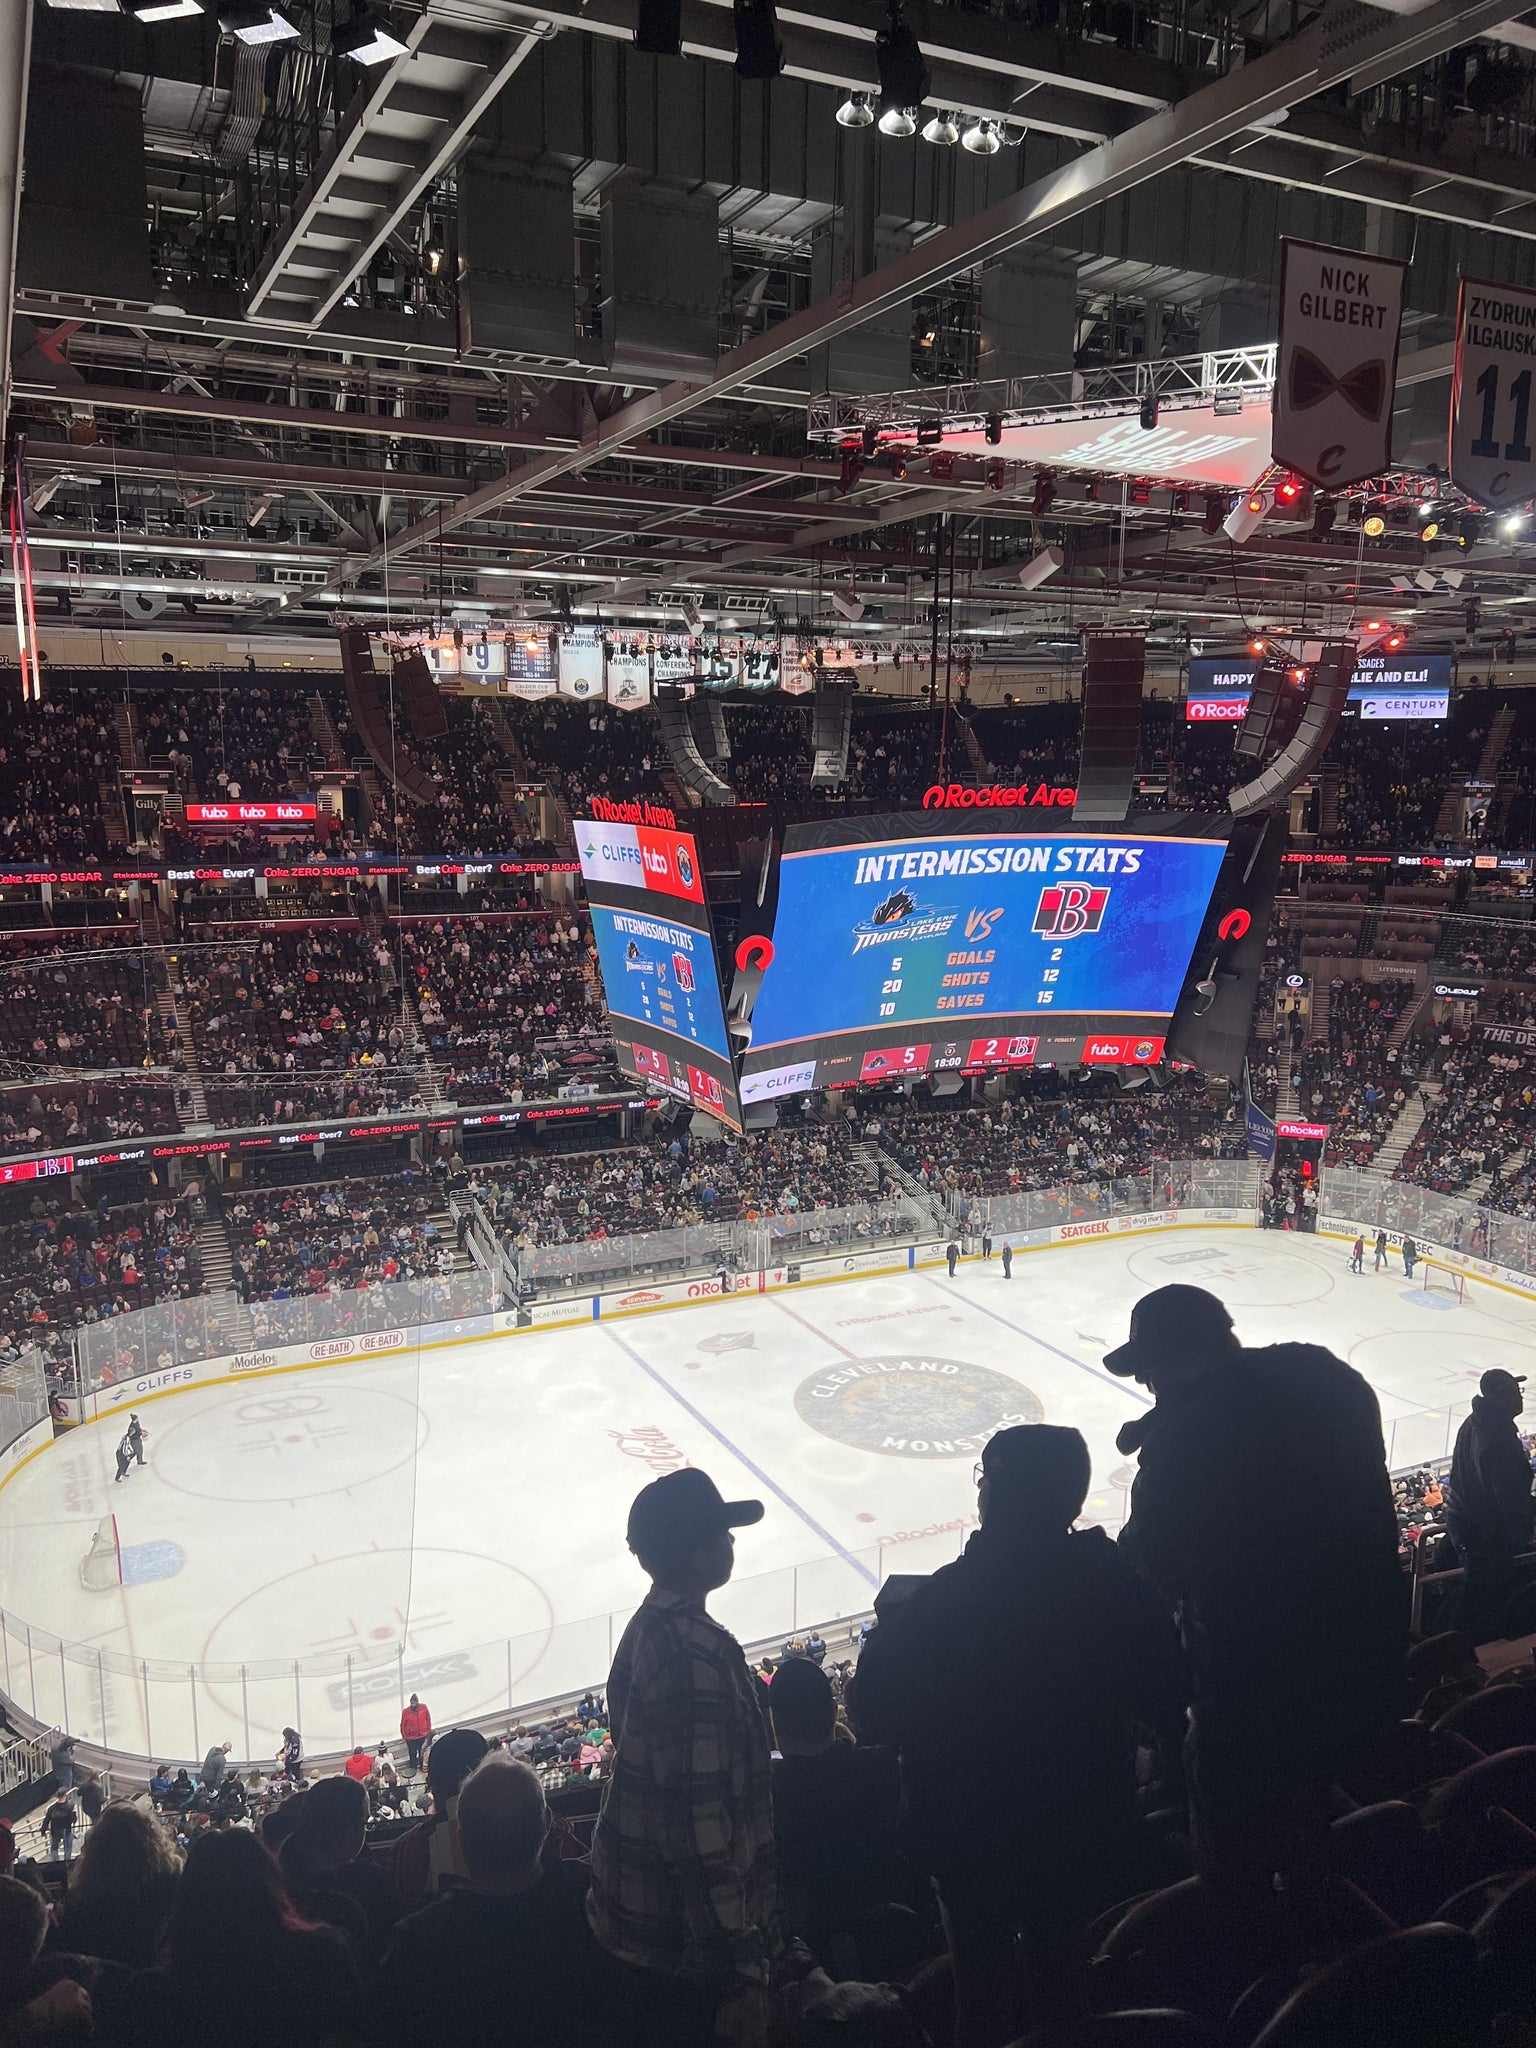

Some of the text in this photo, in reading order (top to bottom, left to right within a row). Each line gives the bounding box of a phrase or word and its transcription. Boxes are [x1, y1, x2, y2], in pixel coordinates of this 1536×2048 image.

[1320, 265, 1370, 297] NICK
[1299, 292, 1387, 329] GILBERT
[1467, 324, 1536, 355] ILGAUSK
[1470, 364, 1532, 462] 11
[1049, 449, 1188, 471] FEAR THE
[1316, 444, 1346, 477] C
[1489, 472, 1511, 497] C
[475, 643, 489, 670] 9
[609, 658, 647, 667] CHAMPIONS
[1357, 658, 1385, 669] SSAGES
[1213, 673, 1255, 685] HAPPY
[1375, 671, 1401, 683] AND
[1404, 668, 1428, 682] ELI!
[1385, 700, 1446, 709] CENTURY
[944, 783, 1029, 808] Rocket
[201, 806, 303, 818] fubo fubo fubo
[603, 798, 677, 829] Rocket Arena
[602, 844, 641, 865] CLIFFS
[643, 846, 668, 874] fubo
[1287, 854, 1347, 863] ZERO SUGAR
[1398, 856, 1421, 866] Best
[1421, 857, 1444, 866] Coke
[1444, 857, 1472, 867] Ever?
[264, 867, 359, 877] Coke ZERO SUGAR
[416, 864, 492, 874] Best Coke Ever?
[501, 863, 522, 872] Coke
[523, 863, 550, 871] ZERO
[854, 847, 1144, 885] INTERMISSION STATS
[25, 873, 58, 883] ZERO
[60, 872, 102, 881] SUGAR
[167, 868, 255, 880] Best Coke Ever?
[910, 914, 959, 927] LAKE ERIE
[963, 904, 1005, 943] VS
[613, 915, 694, 951] INTERMISSION STATS
[852, 920, 953, 956] MONSTERS
[946, 950, 995, 966] GOALS
[1050, 947, 1063, 961] 2
[891, 957, 902, 972] 5
[942, 972, 990, 988] SHOTS
[1043, 969, 1060, 982] 12
[882, 979, 902, 994] 20
[936, 994, 985, 1010] SAVES
[1037, 990, 1054, 1003] 15
[879, 1002, 896, 1016] 10
[1483, 1027, 1515, 1044] THE
[985, 1039, 998, 1056] 2
[1090, 1043, 1119, 1056] fubo
[651, 1051, 660, 1068] 5
[903, 1047, 916, 1064] 5
[934, 1056, 962, 1068] 18:00
[695, 1070, 704, 1090] 2
[766, 1071, 812, 1089] CLIFFS
[544, 1108, 564, 1118] ZERO
[565, 1106, 590, 1115] SUGAR
[628, 1100, 645, 1109] Best
[463, 1116, 482, 1125] Best
[500, 1112, 521, 1122] Ever?
[279, 1134, 300, 1143] Best
[319, 1130, 342, 1140] Ever?
[369, 1126, 391, 1135] ZERO
[392, 1123, 420, 1133] SUGAR
[1289, 1125, 1324, 1136] Rocket
[175, 1145, 199, 1155] ZERO
[200, 1142, 230, 1152] SUGAR
[77, 1156, 99, 1167] Best
[119, 1150, 145, 1161] Ever?
[4, 1170, 13, 1179] 2
[1060, 1221, 1110, 1239] SEATGEEK
[850, 1304, 951, 1325] Rocket Arena
[234, 1354, 271, 1369] Modelo
[136, 1369, 193, 1392] CLIFFS
[811, 1361, 960, 1399] CLEVELAND
